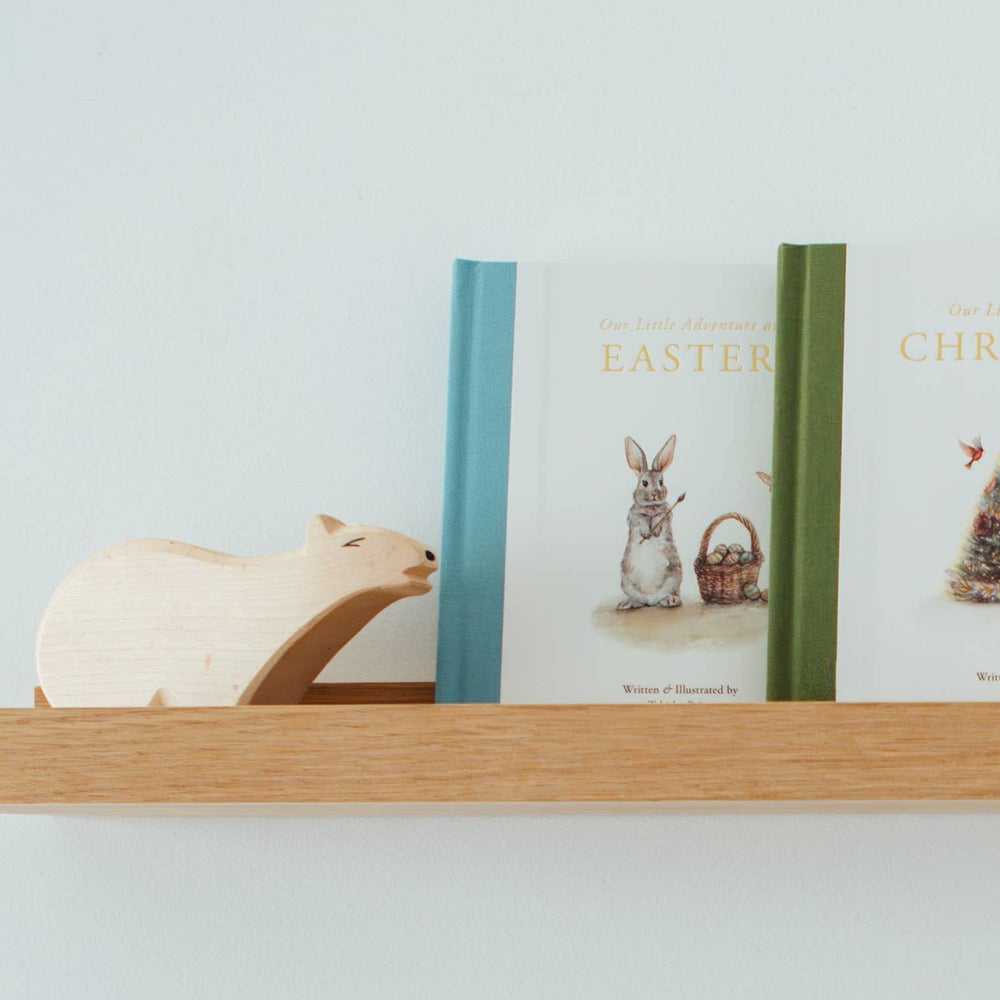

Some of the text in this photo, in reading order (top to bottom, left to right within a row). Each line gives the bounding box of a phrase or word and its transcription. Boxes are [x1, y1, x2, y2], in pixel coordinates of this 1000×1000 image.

[949, 303, 980, 317] Our
[600, 318, 629, 331] Our
[635, 316, 676, 331] Little
[681, 317, 757, 331] Adventure
[602, 344, 774, 372] EASTER
[623, 684, 739, 697] Written & Illustrated by
